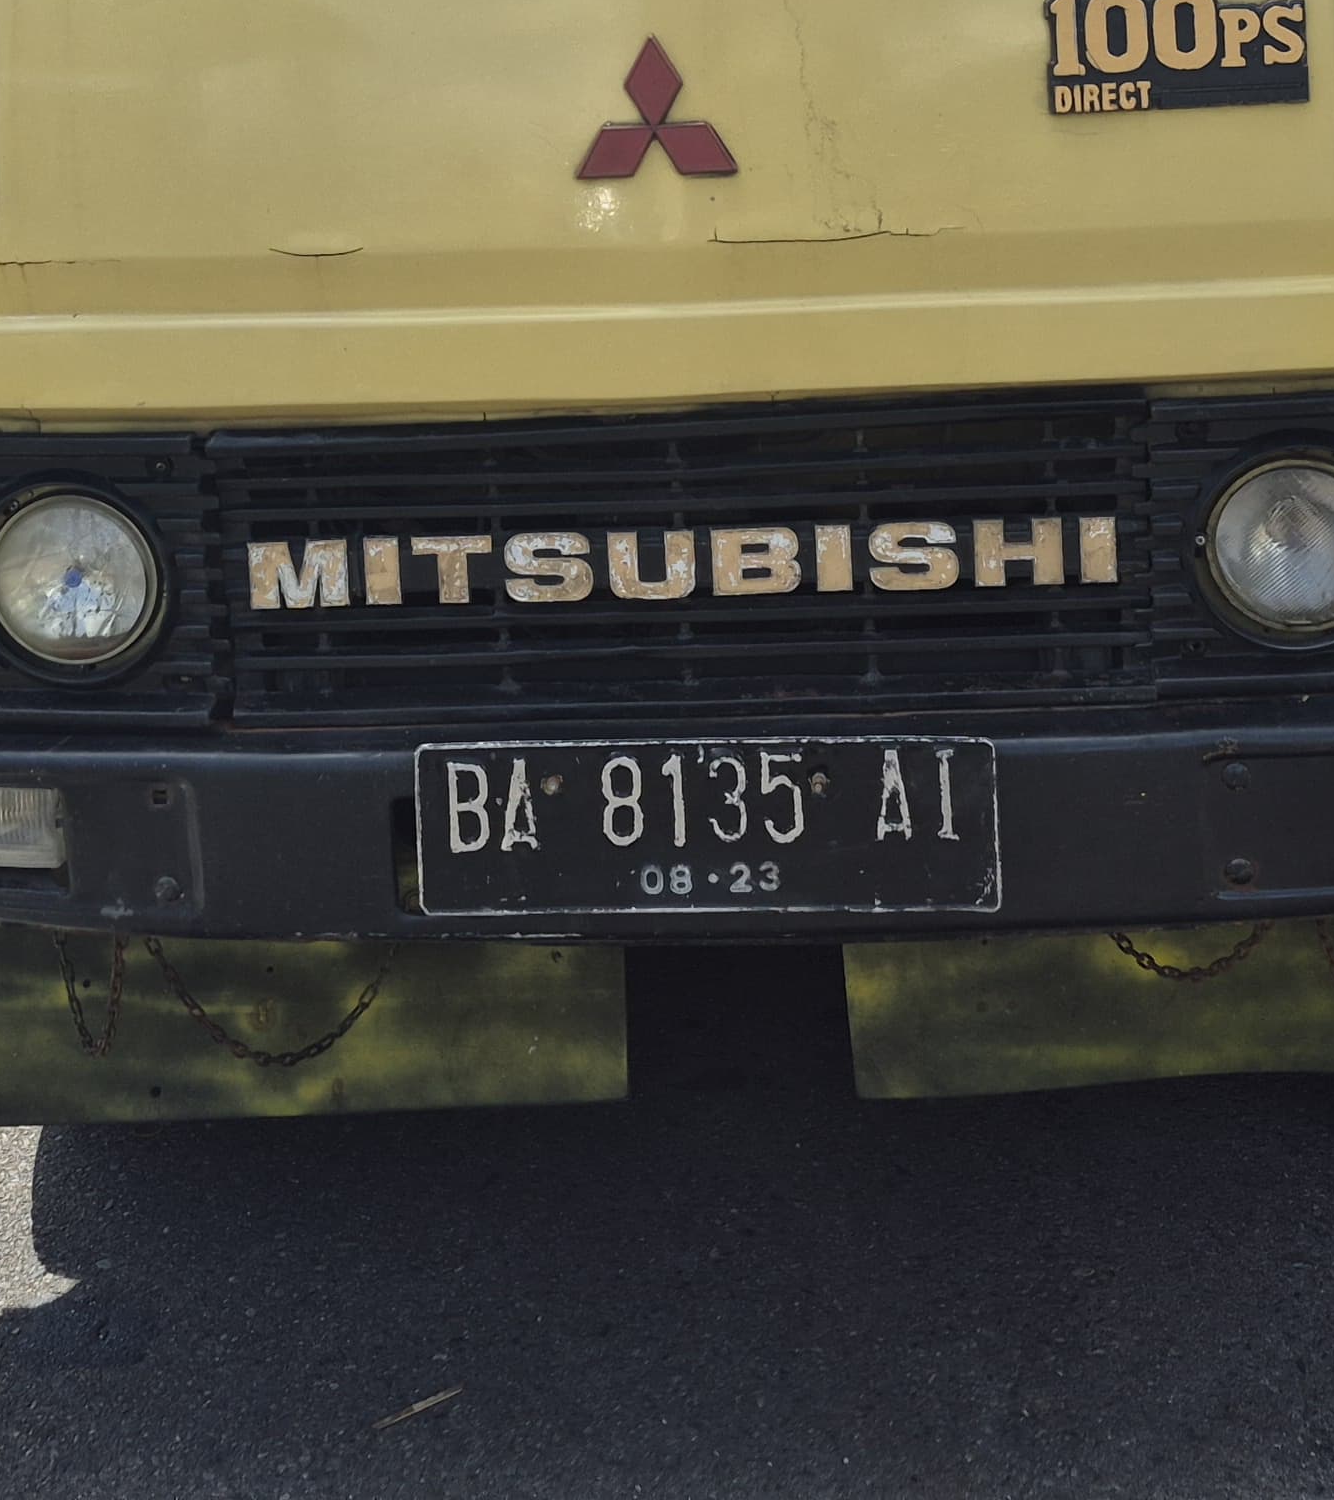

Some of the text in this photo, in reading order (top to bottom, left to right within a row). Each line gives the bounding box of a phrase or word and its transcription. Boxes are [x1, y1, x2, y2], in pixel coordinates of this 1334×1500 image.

[1054, 80, 1153, 113] DIRECT
[246, 515, 1119, 611] MITSUBISHI
[447, 757, 539, 854] BA
[601, 750, 806, 849] 8135
